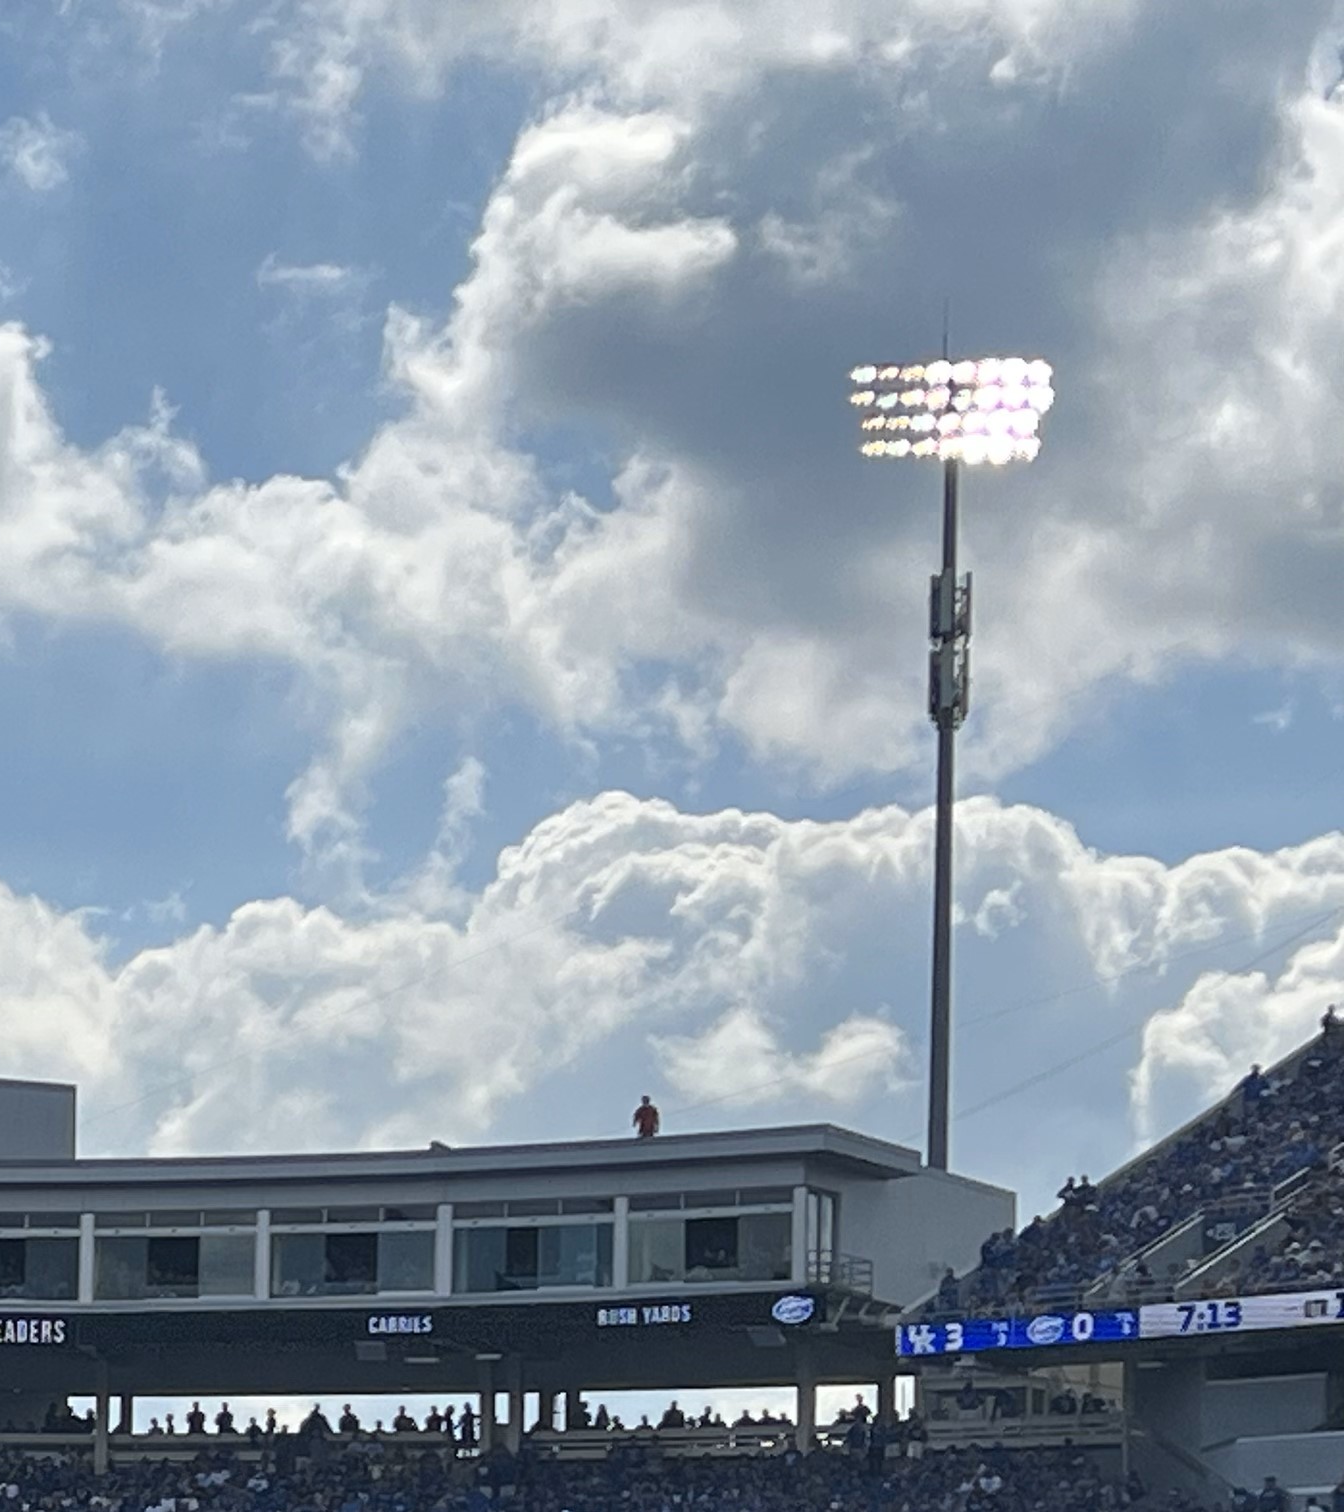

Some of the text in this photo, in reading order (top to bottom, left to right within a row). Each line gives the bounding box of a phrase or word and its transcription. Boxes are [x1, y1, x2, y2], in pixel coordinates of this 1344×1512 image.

[1072, 1313, 1094, 1340] 0
[1177, 1302, 1242, 1332] 7:13
[945, 1323, 963, 1351] 3
